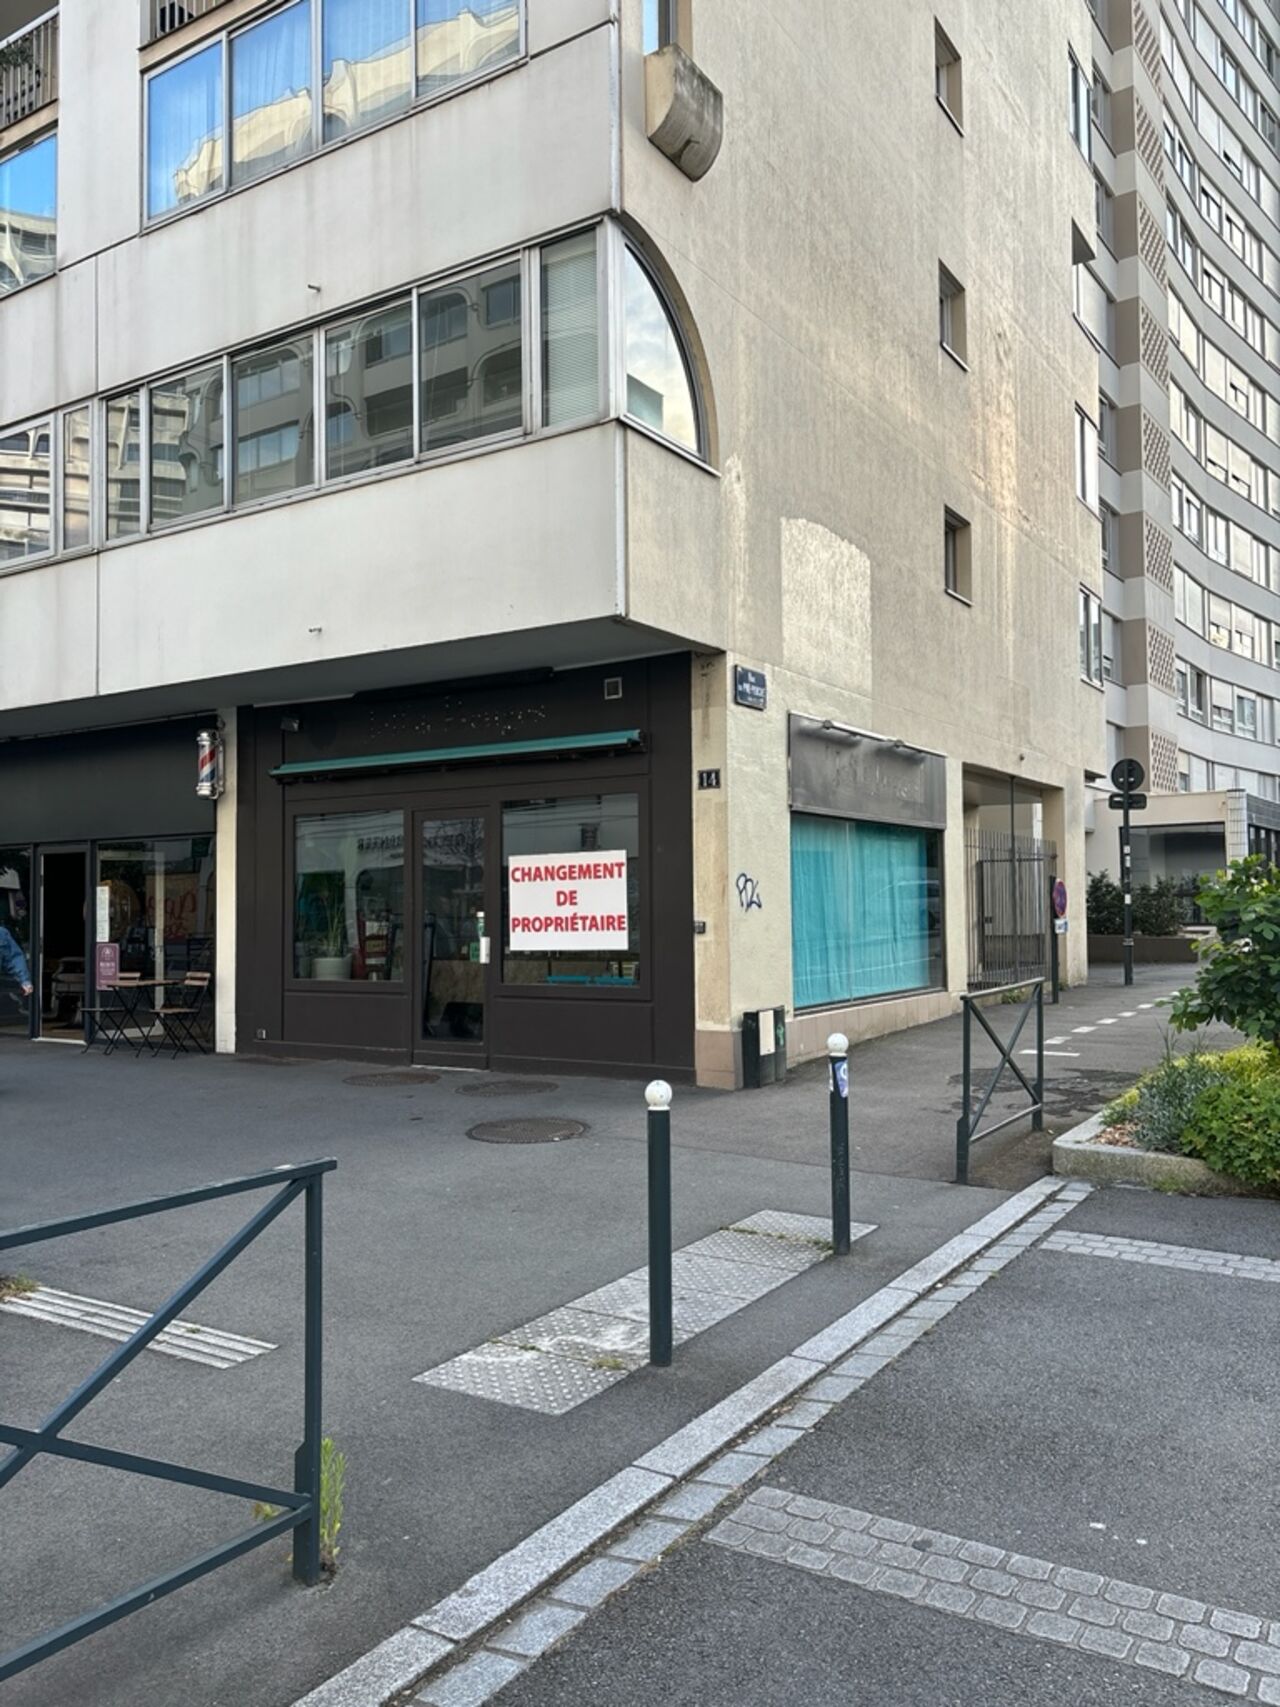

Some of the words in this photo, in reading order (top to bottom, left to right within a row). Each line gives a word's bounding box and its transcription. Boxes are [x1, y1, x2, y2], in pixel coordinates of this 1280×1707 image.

[702, 772, 716, 786] 14
[511, 862, 625, 882] CHANGEMENT
[556, 890, 578, 907] DE
[511, 912, 627, 933] PROPRIÉTAIRE
